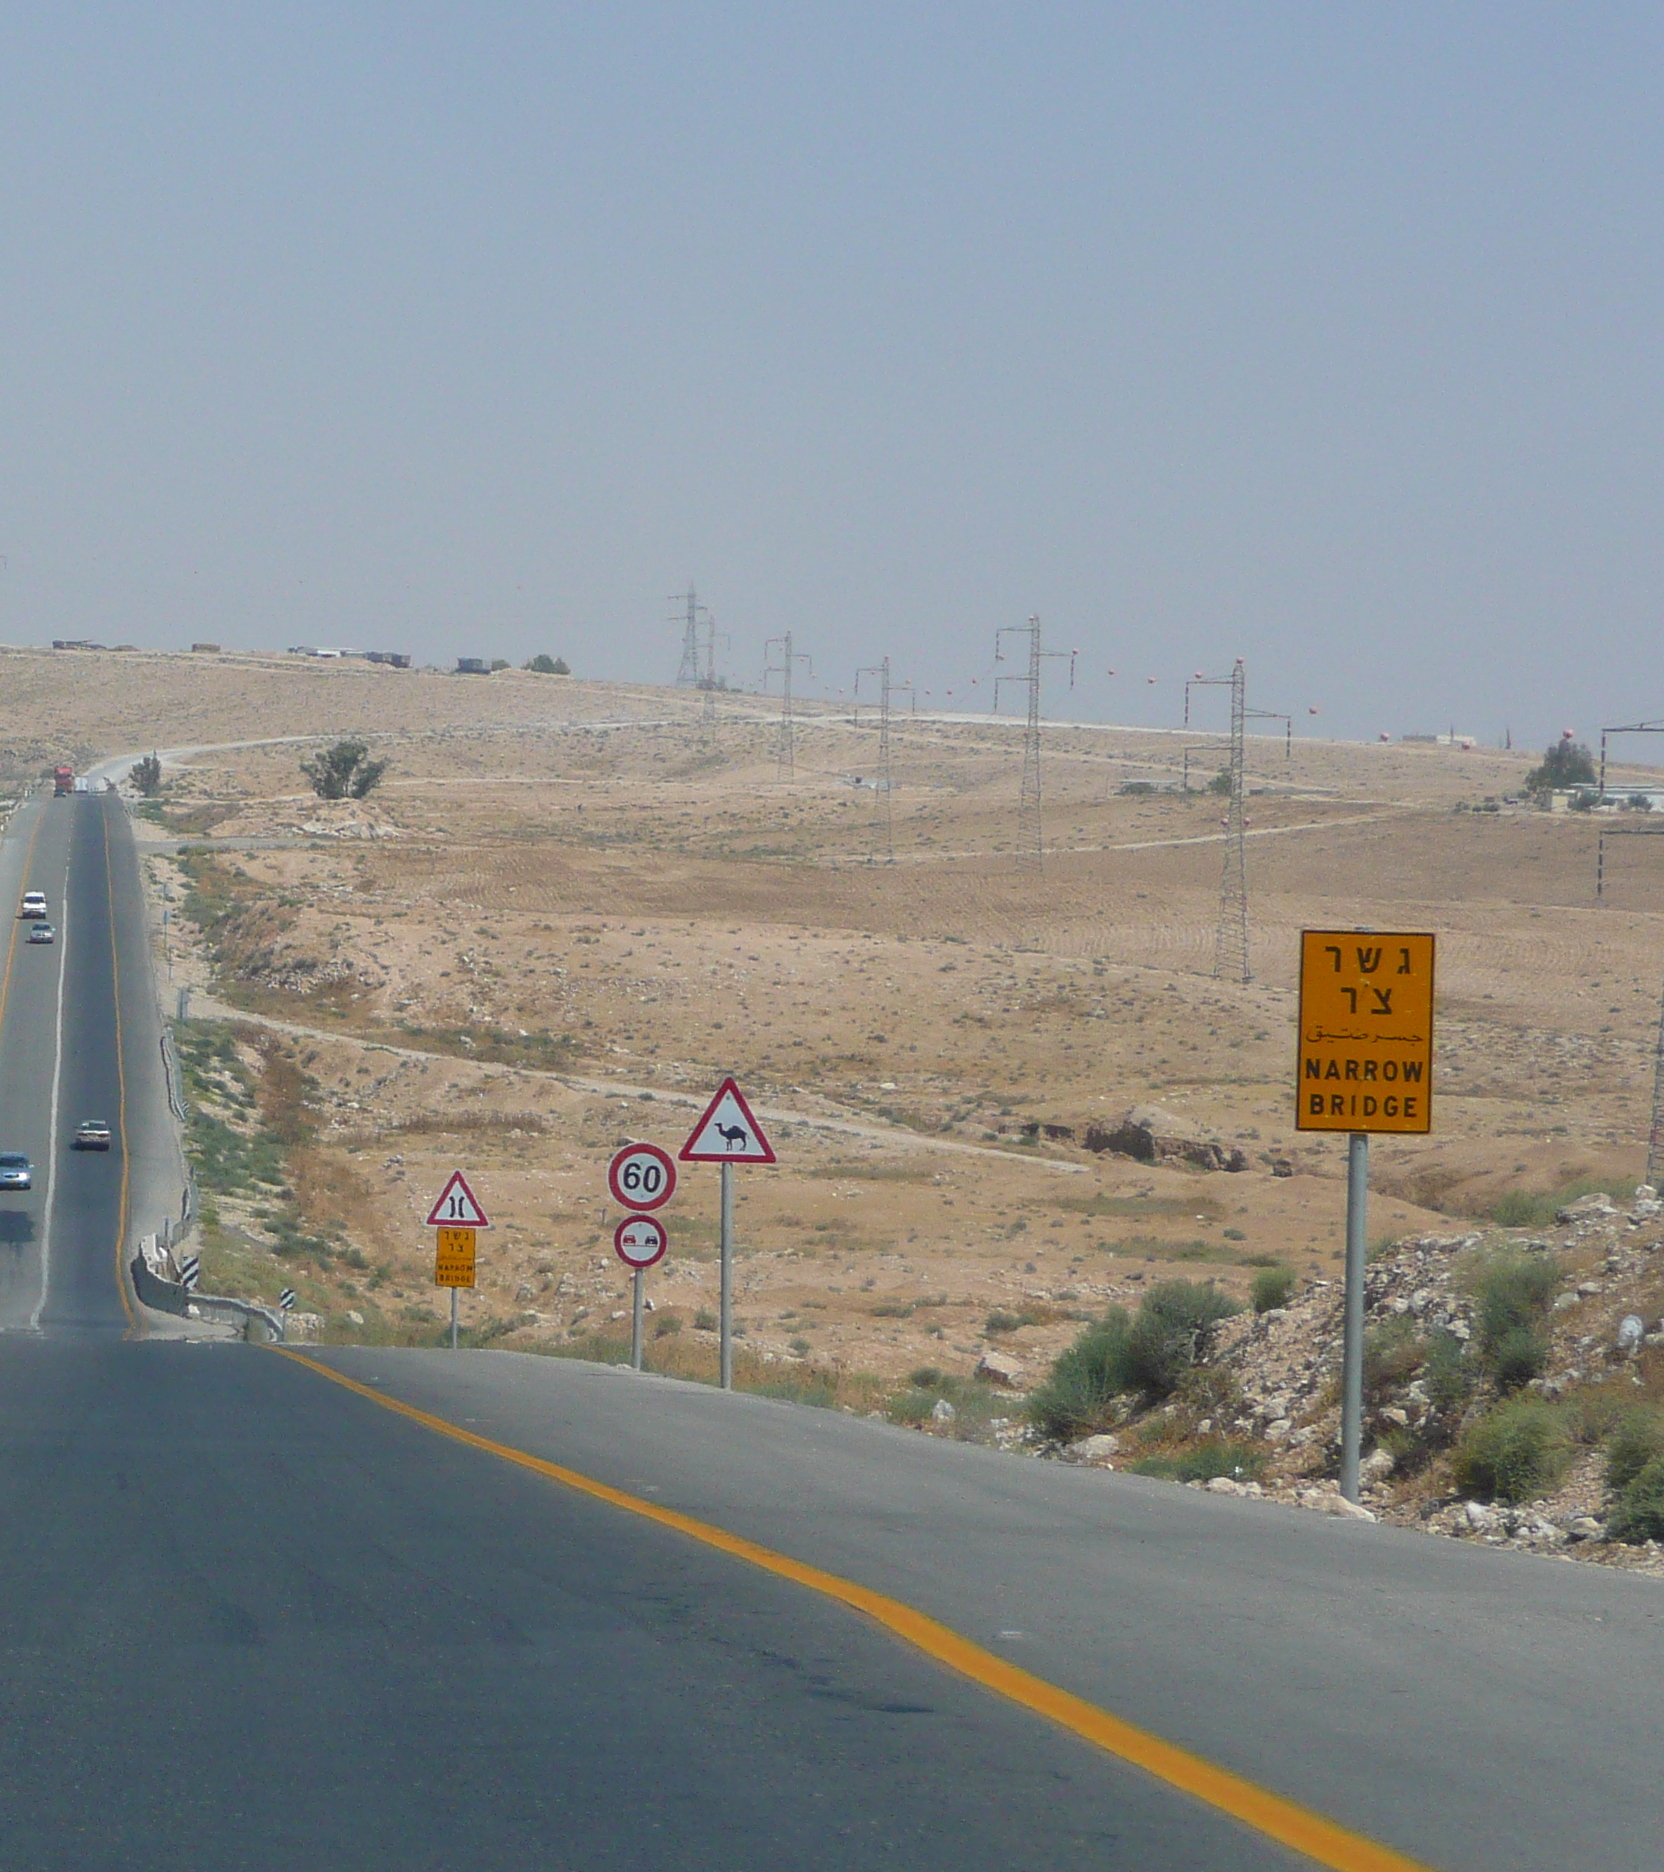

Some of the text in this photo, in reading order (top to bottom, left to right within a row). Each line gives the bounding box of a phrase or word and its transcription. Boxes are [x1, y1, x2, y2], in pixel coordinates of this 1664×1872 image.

[1325, 946, 1411, 974] גשר
[1340, 987, 1393, 1015] צר
[1370, 1034, 1424, 1047] جسر
[1305, 1058, 1423, 1083] NARROW
[1309, 1094, 1417, 1118] BRIDGE
[623, 1162, 661, 1193] 60
